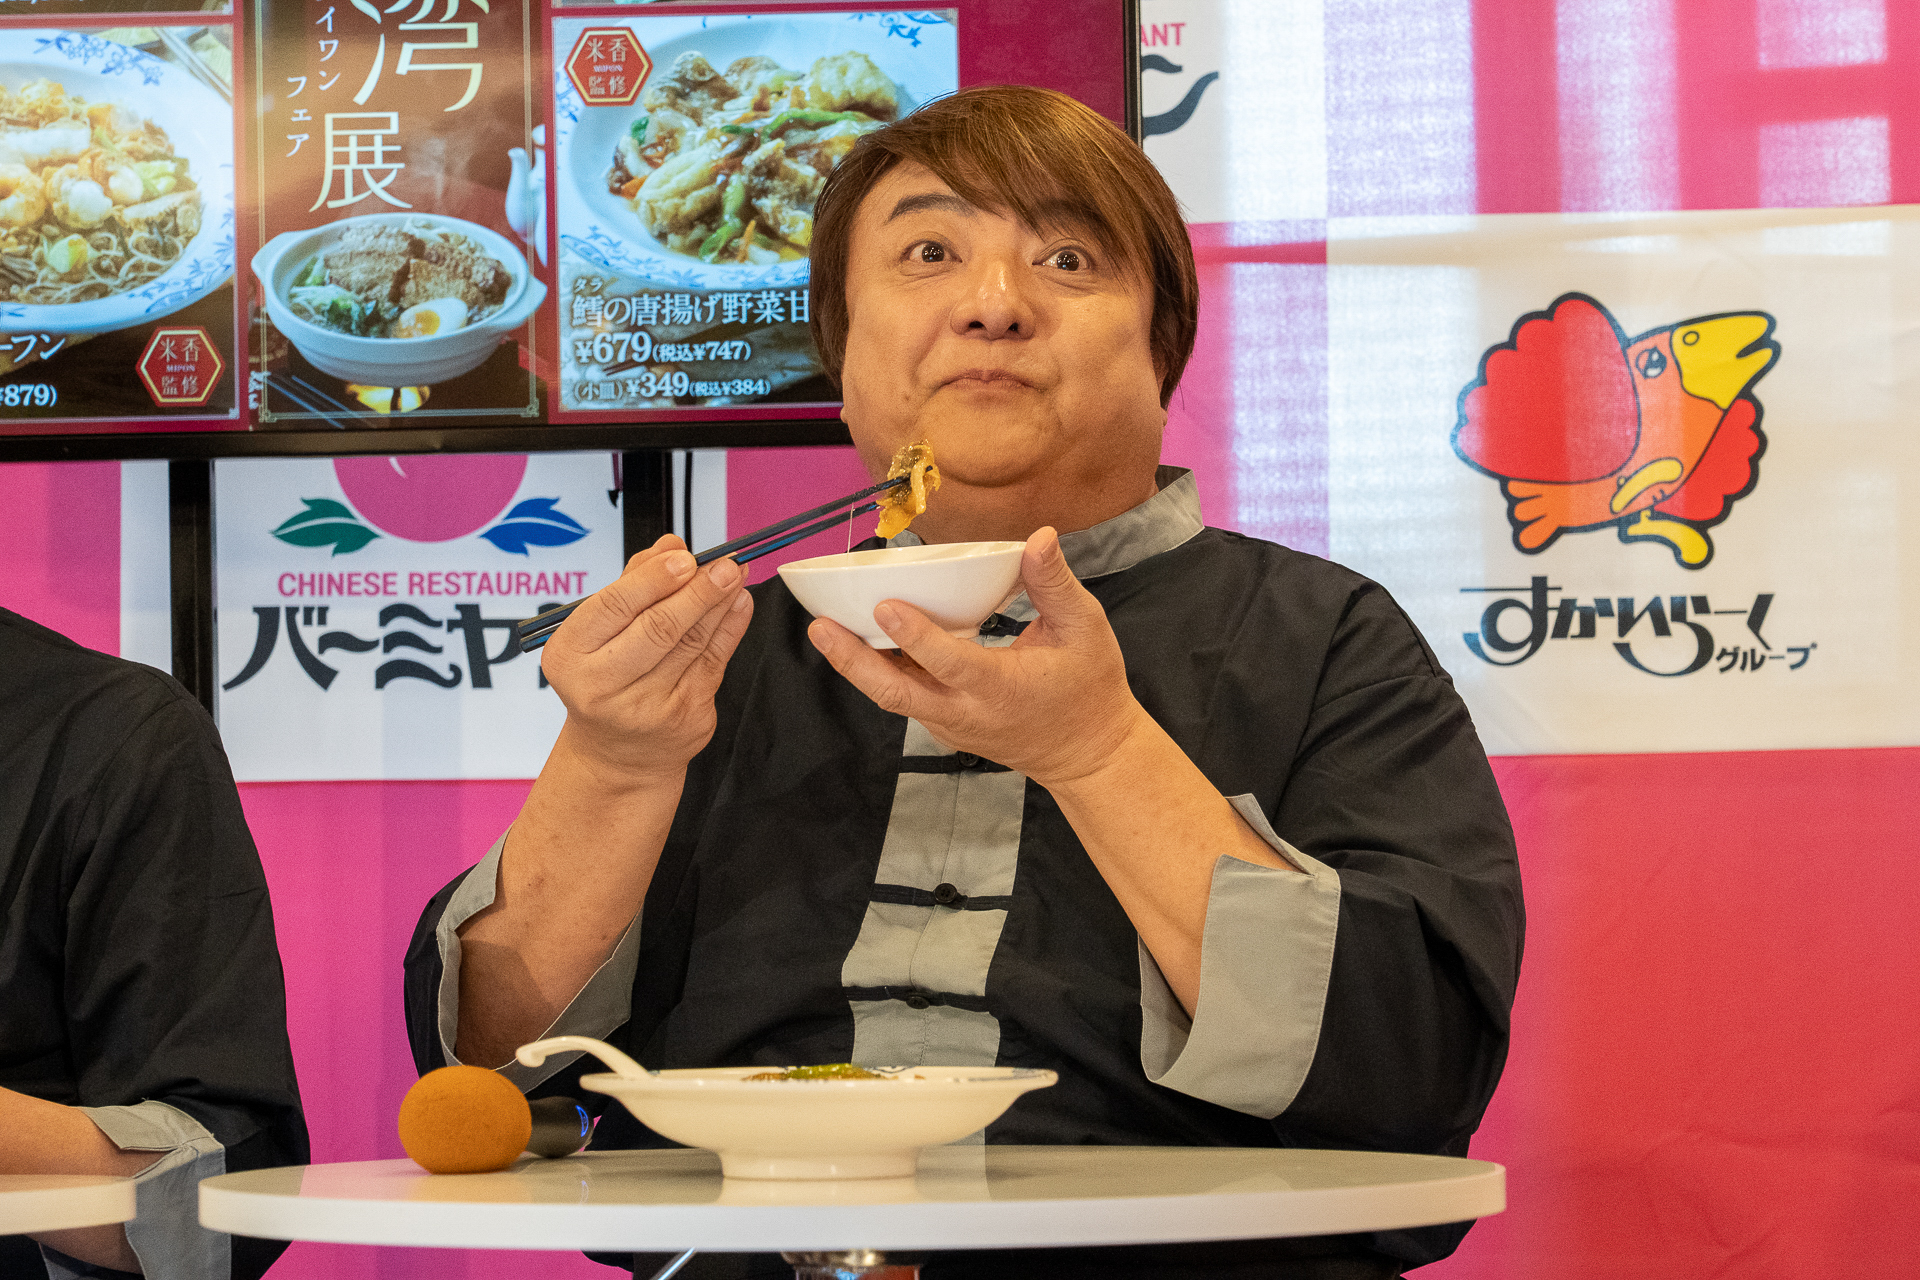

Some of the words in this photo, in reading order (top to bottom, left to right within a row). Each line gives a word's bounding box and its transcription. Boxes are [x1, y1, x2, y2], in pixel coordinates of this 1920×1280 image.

[286, 76, 312, 157] フェア
[574, 277, 603, 293] タラ
[572, 289, 809, 326] 鱈の唐揚げ野菜甘
[278, 572, 398, 597] CHINESE
[408, 571, 588, 596] RESTAURANT
[1459, 575, 1776, 677] すかいらーく
[222, 602, 568, 692] バーミヤ
[1715, 642, 1818, 674] グループ
